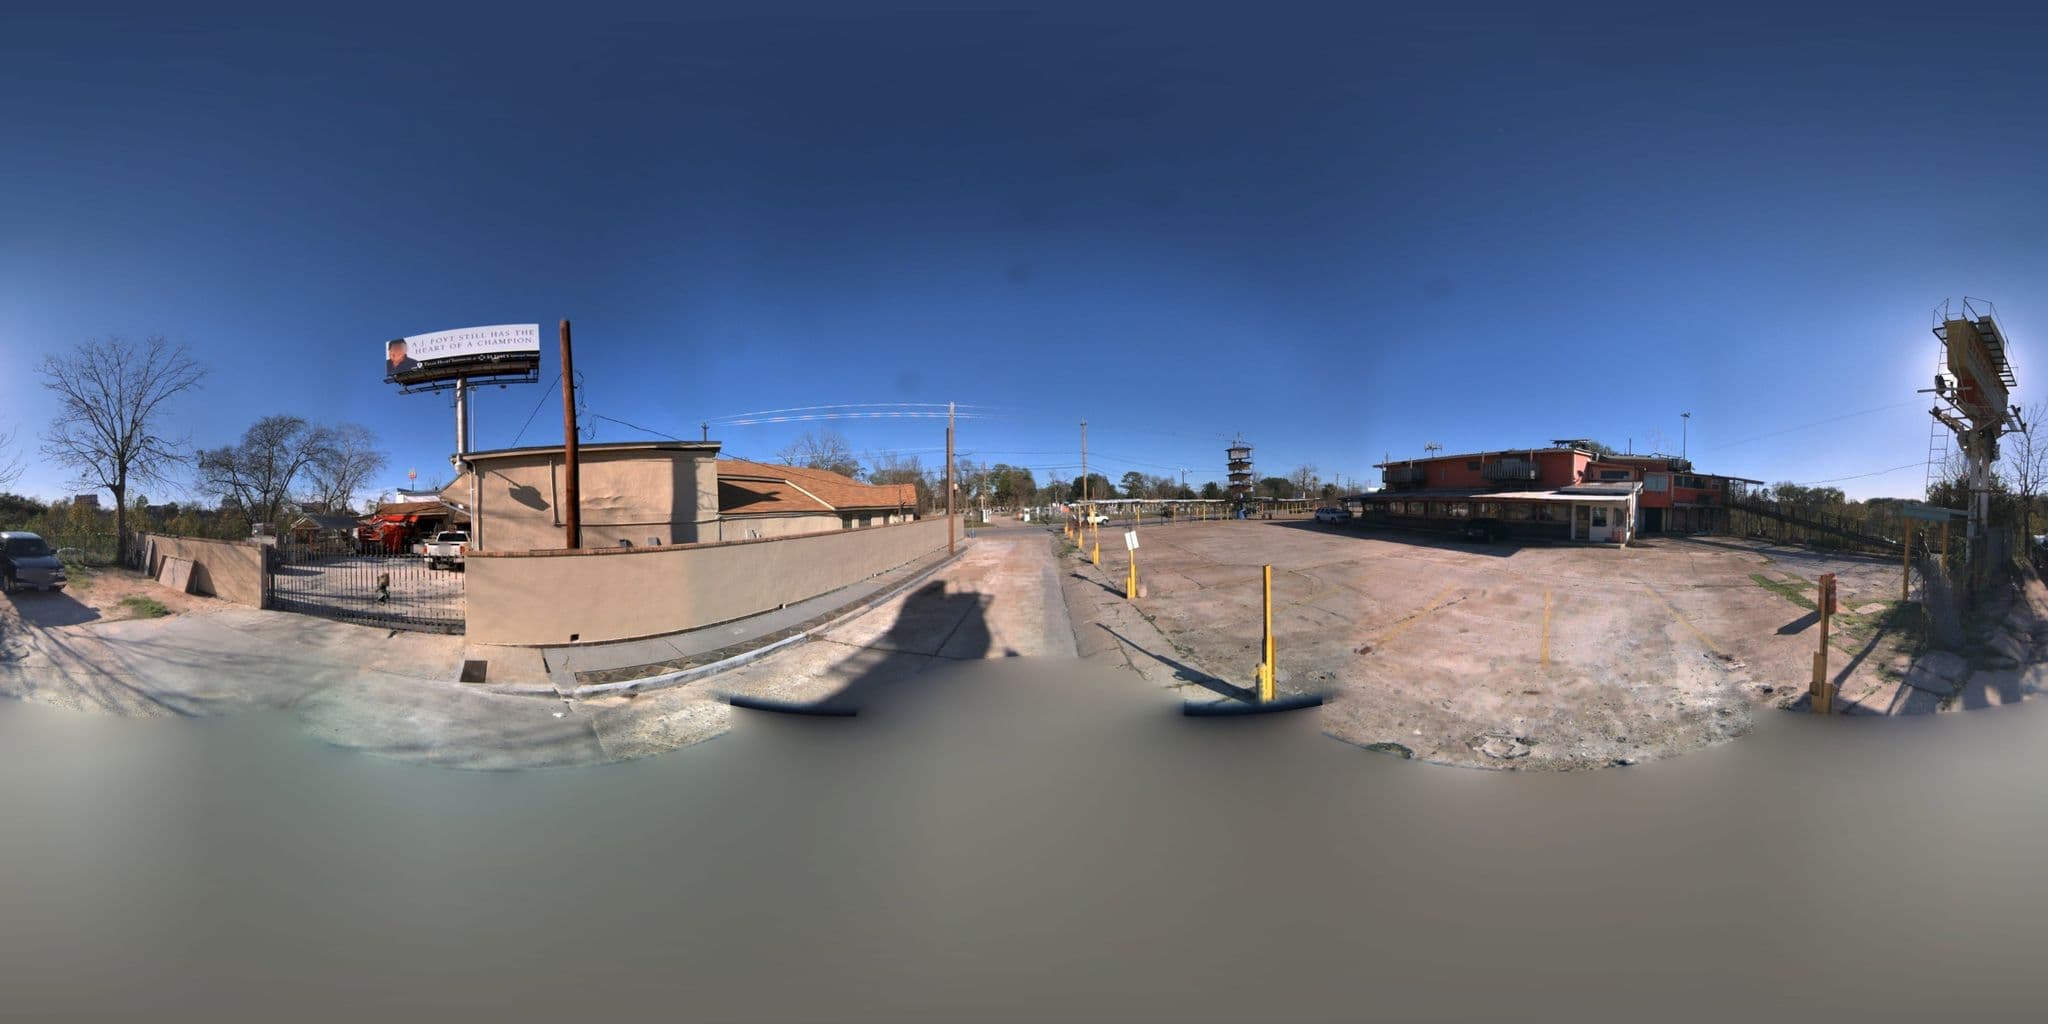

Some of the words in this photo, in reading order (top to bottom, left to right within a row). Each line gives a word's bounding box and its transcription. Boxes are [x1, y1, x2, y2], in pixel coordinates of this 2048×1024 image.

[458, 332, 485, 341] STILL
[490, 330, 511, 338] HAS
[415, 344, 445, 354] HEART
